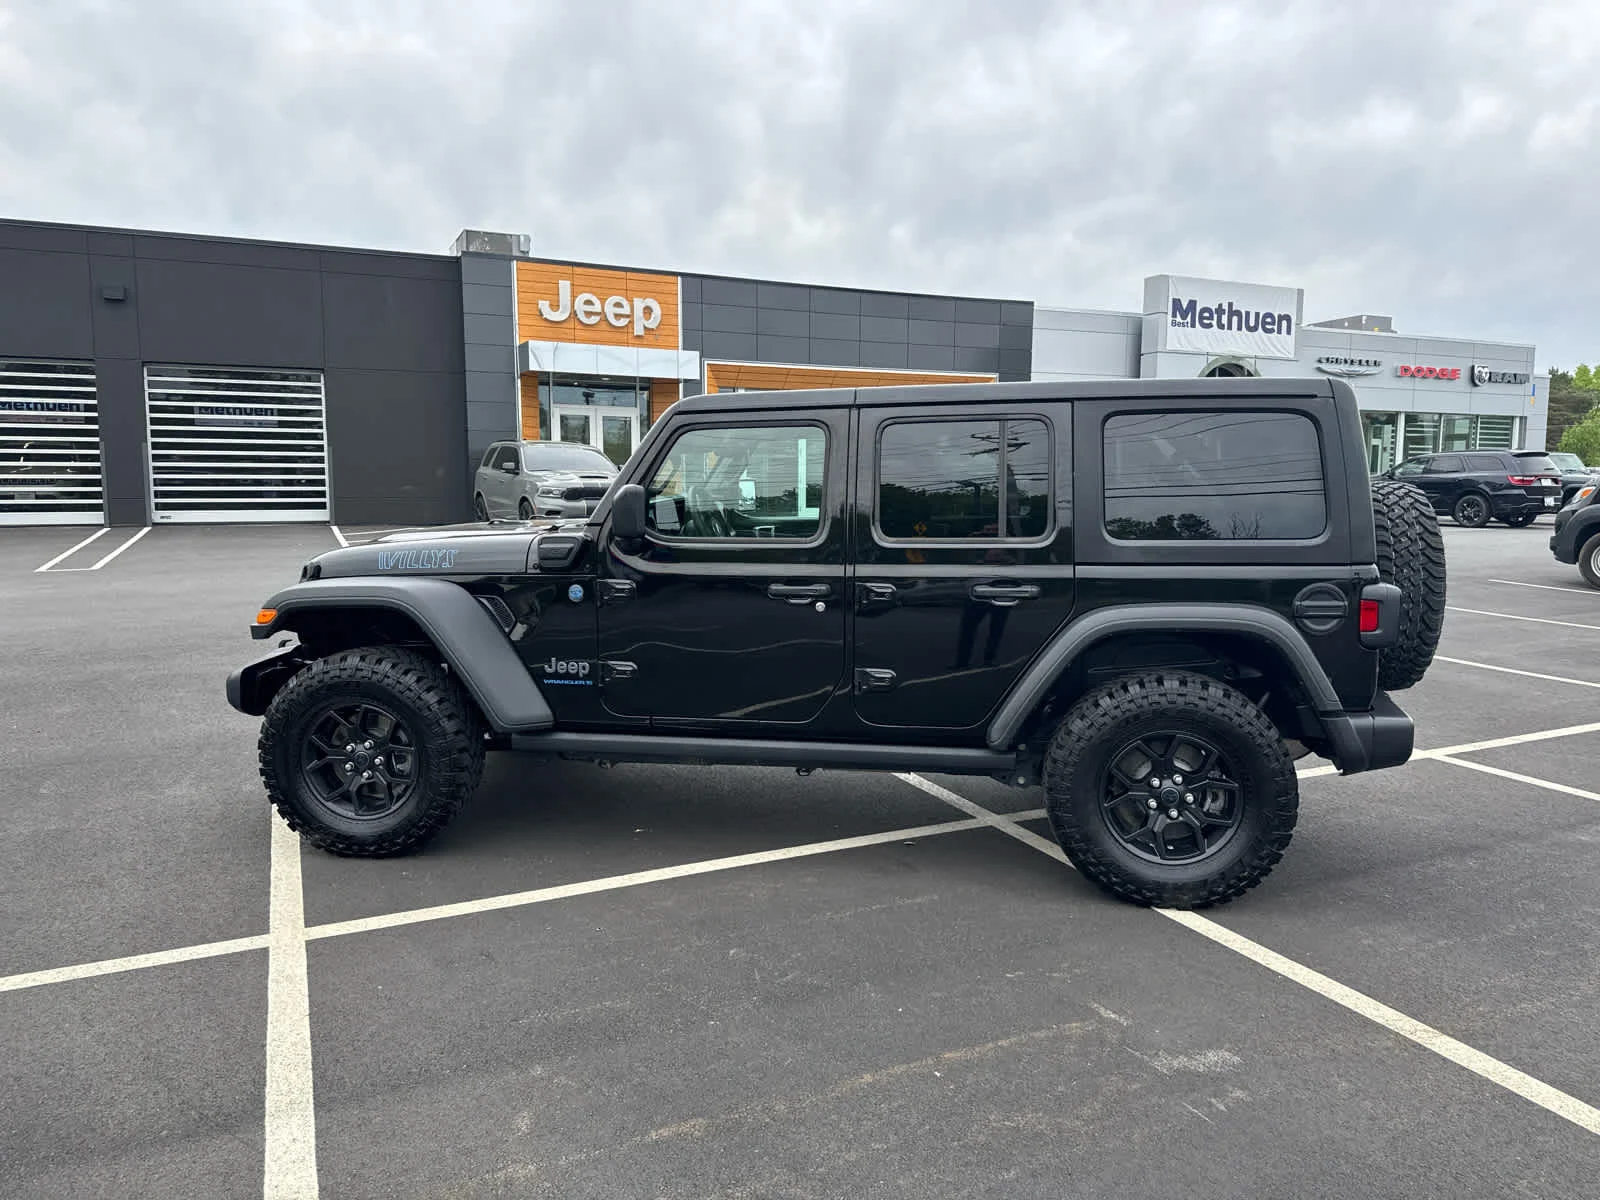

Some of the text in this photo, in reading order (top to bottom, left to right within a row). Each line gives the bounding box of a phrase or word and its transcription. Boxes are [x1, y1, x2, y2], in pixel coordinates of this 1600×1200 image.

[537, 280, 662, 336] Jeep
[1171, 298, 1292, 335] Methuen
[1171, 319, 1189, 328] Best
[1399, 364, 1461, 380] DODGE
[1490, 371, 1530, 384] RAM
[378, 549, 457, 570] WILLYS
[544, 657, 590, 678] Jeep
